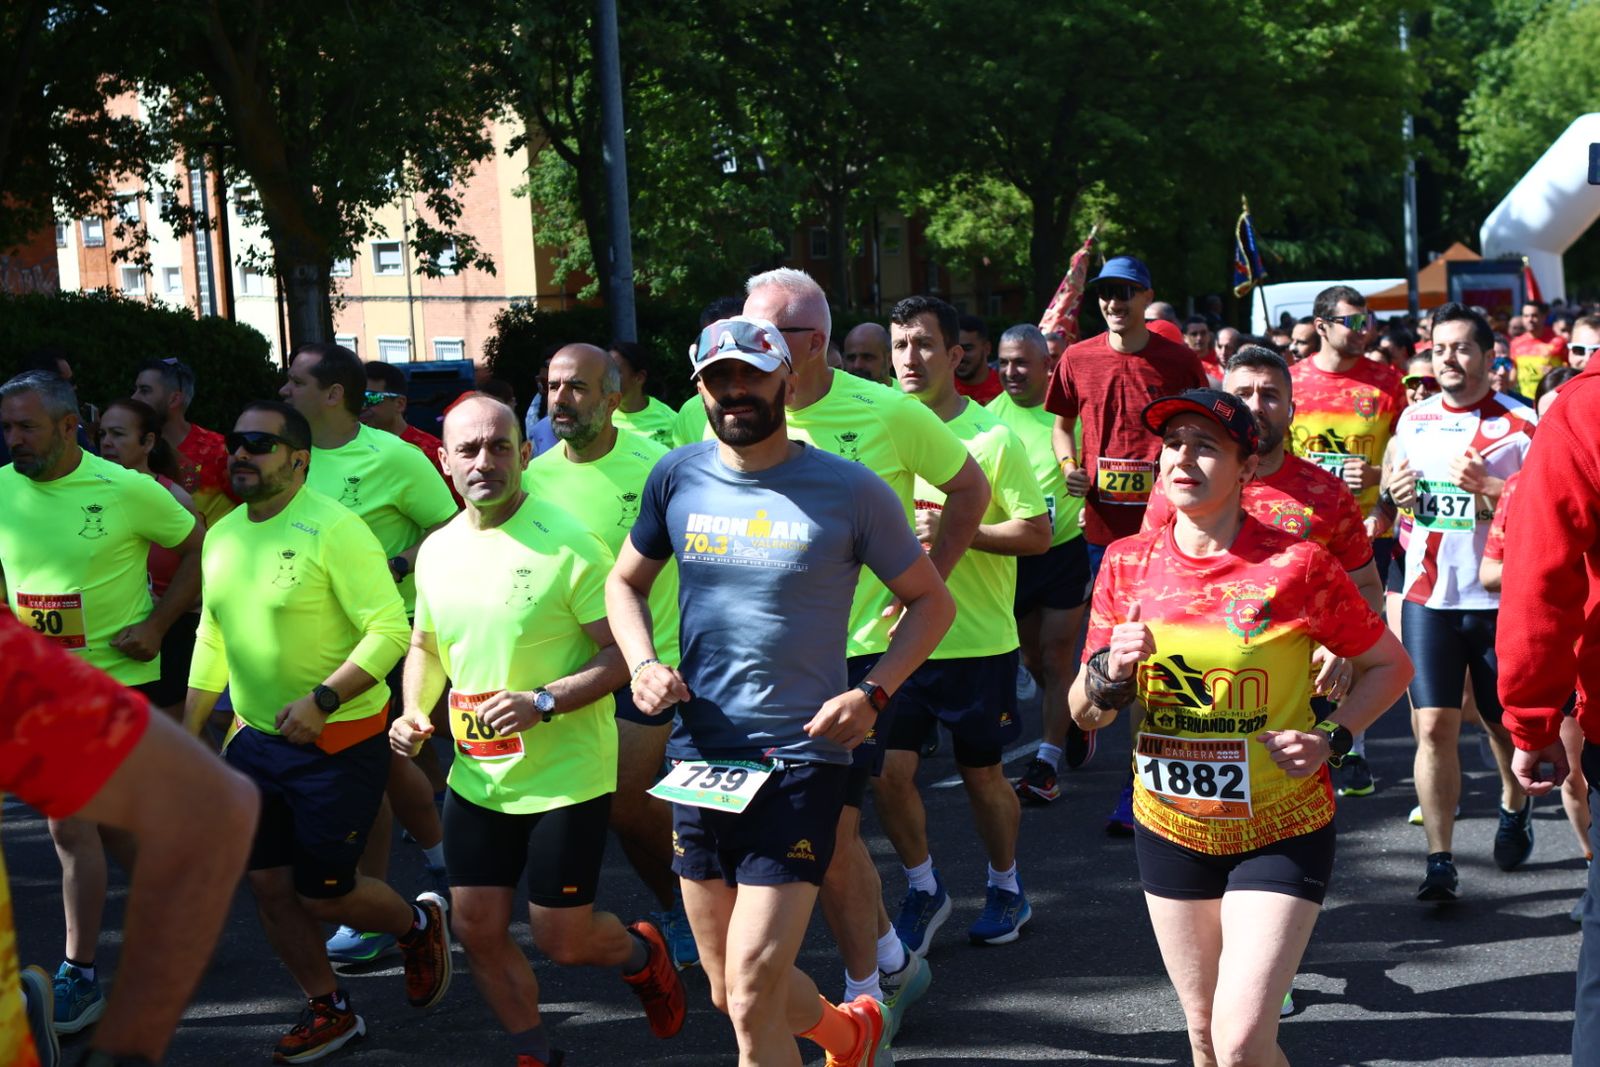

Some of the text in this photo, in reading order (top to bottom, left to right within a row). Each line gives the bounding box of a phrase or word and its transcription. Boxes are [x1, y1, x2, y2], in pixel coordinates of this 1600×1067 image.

[1106, 472, 1145, 492] 278
[1415, 495, 1471, 517] 1437
[686, 509, 810, 541] IRONMAN
[684, 533, 729, 555] 70.3
[31, 610, 63, 635] 30
[1174, 714, 1236, 734] FERNANDO
[1165, 747, 1214, 759] CARRERA
[681, 765, 749, 792] 759
[1144, 758, 1246, 800] 1882
